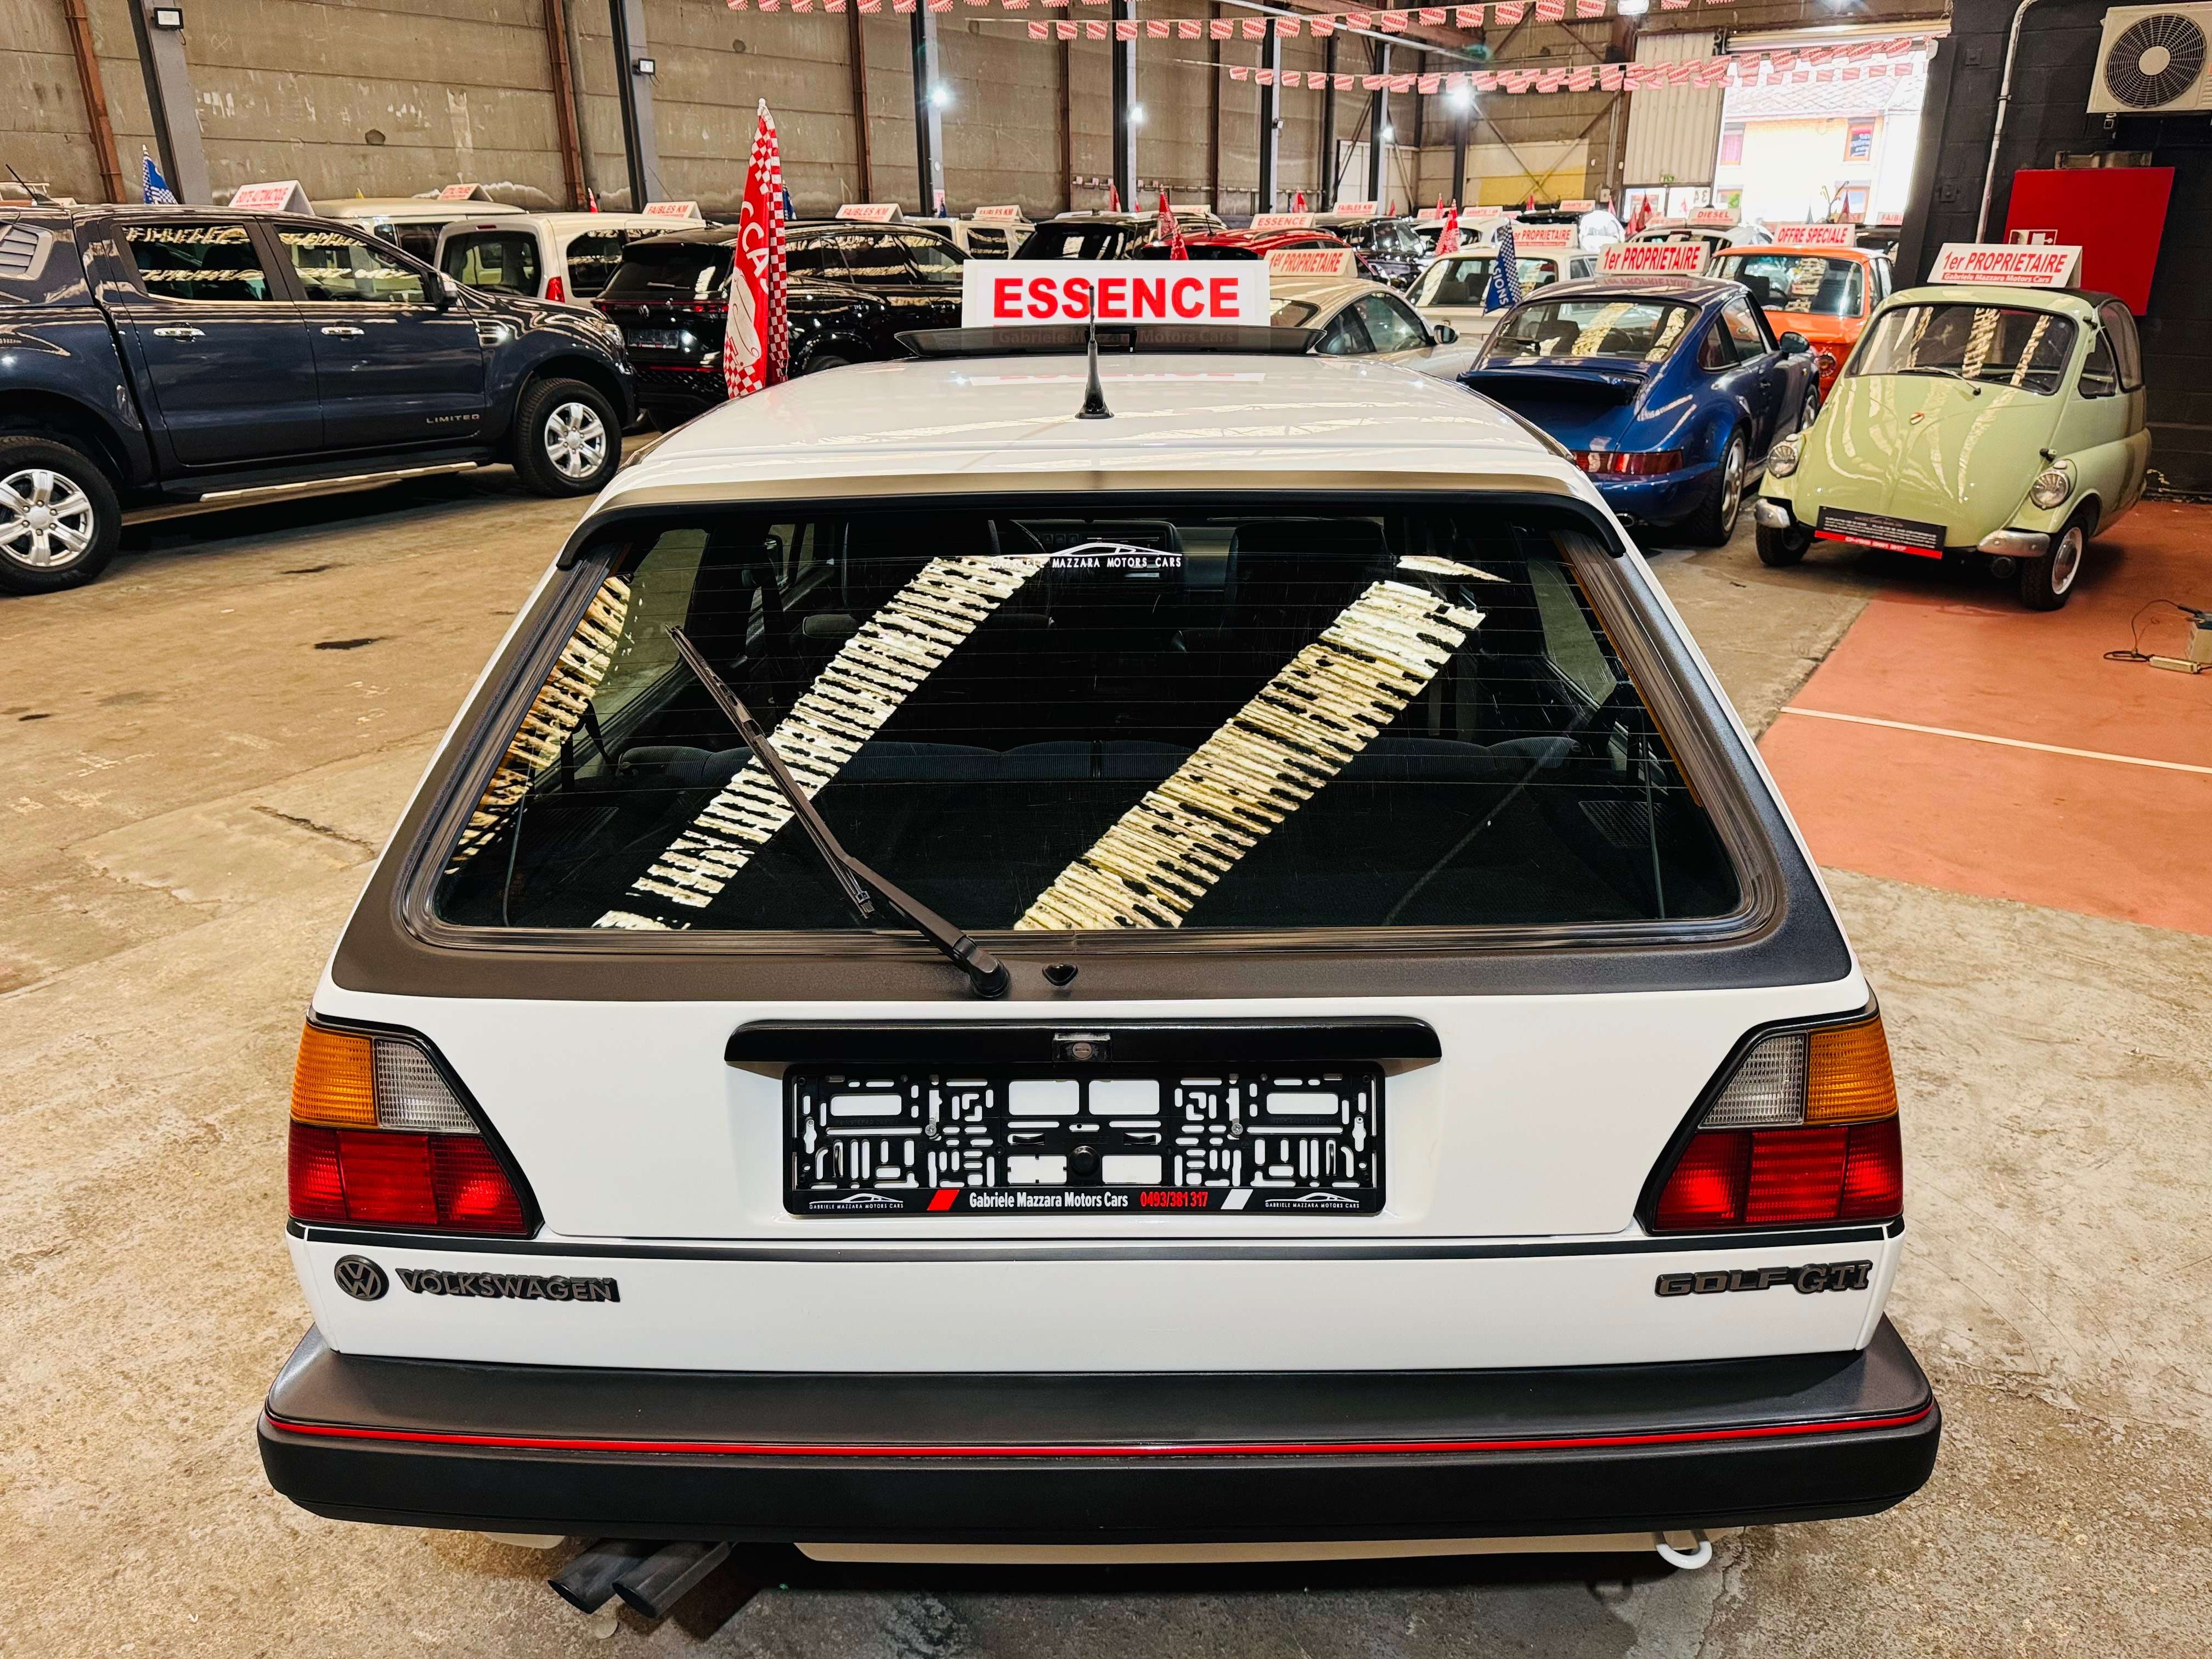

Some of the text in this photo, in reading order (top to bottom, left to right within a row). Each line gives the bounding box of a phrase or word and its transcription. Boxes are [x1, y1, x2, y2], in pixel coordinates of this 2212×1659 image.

[647, 205, 689, 214] FAIBLES KM
[842, 207, 889, 216] FAIBLES KM
[1257, 217, 1307, 226] ESSENCE
[1522, 229, 1571, 240] PROPRIETAIRE
[1778, 228, 1848, 244] OFFRE SPECIALE
[1269, 252, 1343, 273] 1er PROPRIETAIRE
[1603, 246, 1700, 270] 1er PROPRIETAIRE
[1943, 251, 2068, 273] 1er PROPRIETAIRE
[1492, 261, 1509, 305] SIONS
[2033, 275, 2051, 284] Cars
[994, 276, 1240, 319] ESSENCE
[1000, 330, 1070, 344] Gabriele
[1140, 330, 1196, 343] Motors
[1200, 330, 1234, 343] Cars
[426, 414, 479, 424] LIMITED
[1052, 557, 1100, 568] MAZZARA
[1107, 557, 1147, 568] MOTORS
[1155, 557, 1181, 568] CARS
[969, 1192, 1014, 1207] Gabriele
[1017, 1192, 1062, 1207] Mazzara
[1064, 1192, 1102, 1207] Motors
[1104, 1191, 1128, 1207] Cars
[395, 1268, 620, 1302] VOLKSWAGEN
[1655, 1259, 1873, 1297] GOLF GTI
